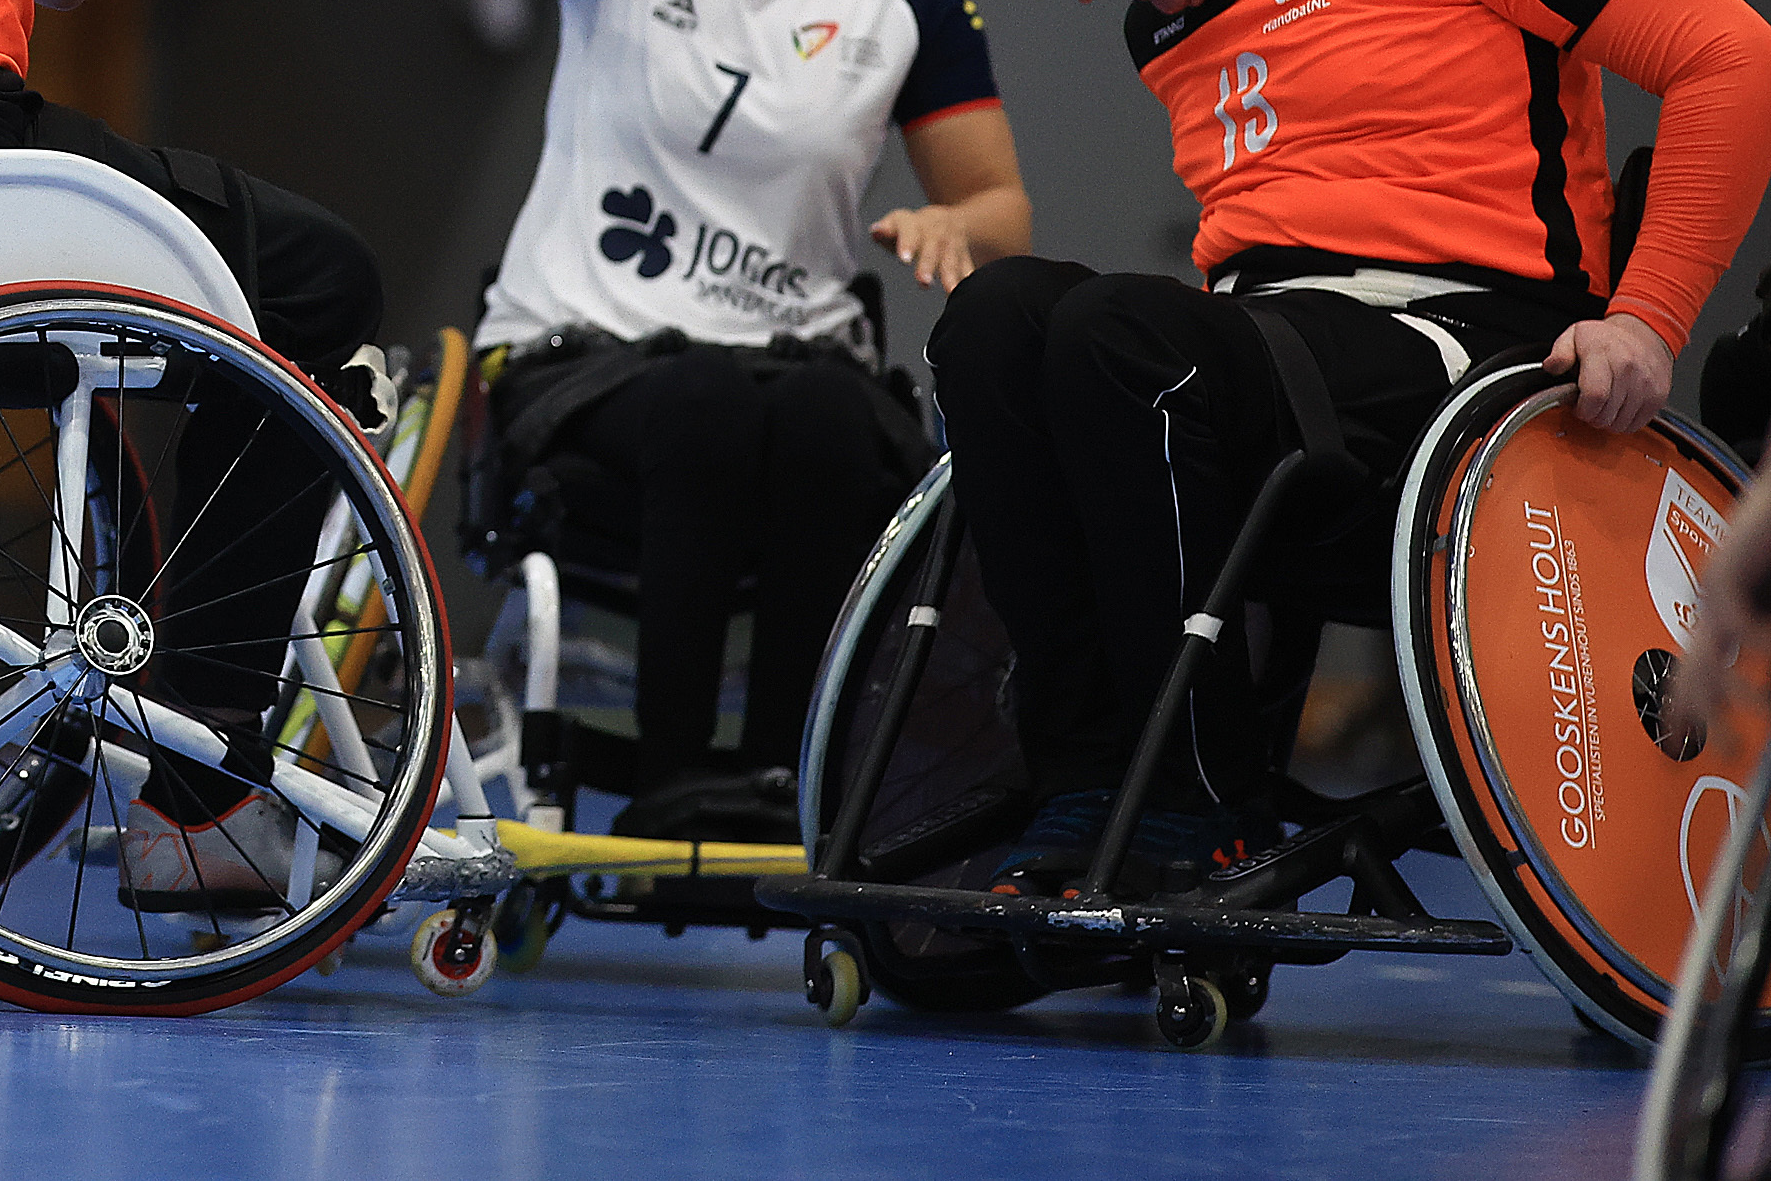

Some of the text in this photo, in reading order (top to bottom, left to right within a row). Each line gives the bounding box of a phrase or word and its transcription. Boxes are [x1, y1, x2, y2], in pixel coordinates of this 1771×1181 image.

[695, 62, 752, 155] 7
[1213, 50, 1279, 172] 13
[1568, 572, 1584, 615] SINDS
[1523, 501, 1589, 849] GOOSKENS HOUT
[1589, 721, 1606, 822] SPECIALISTEN
